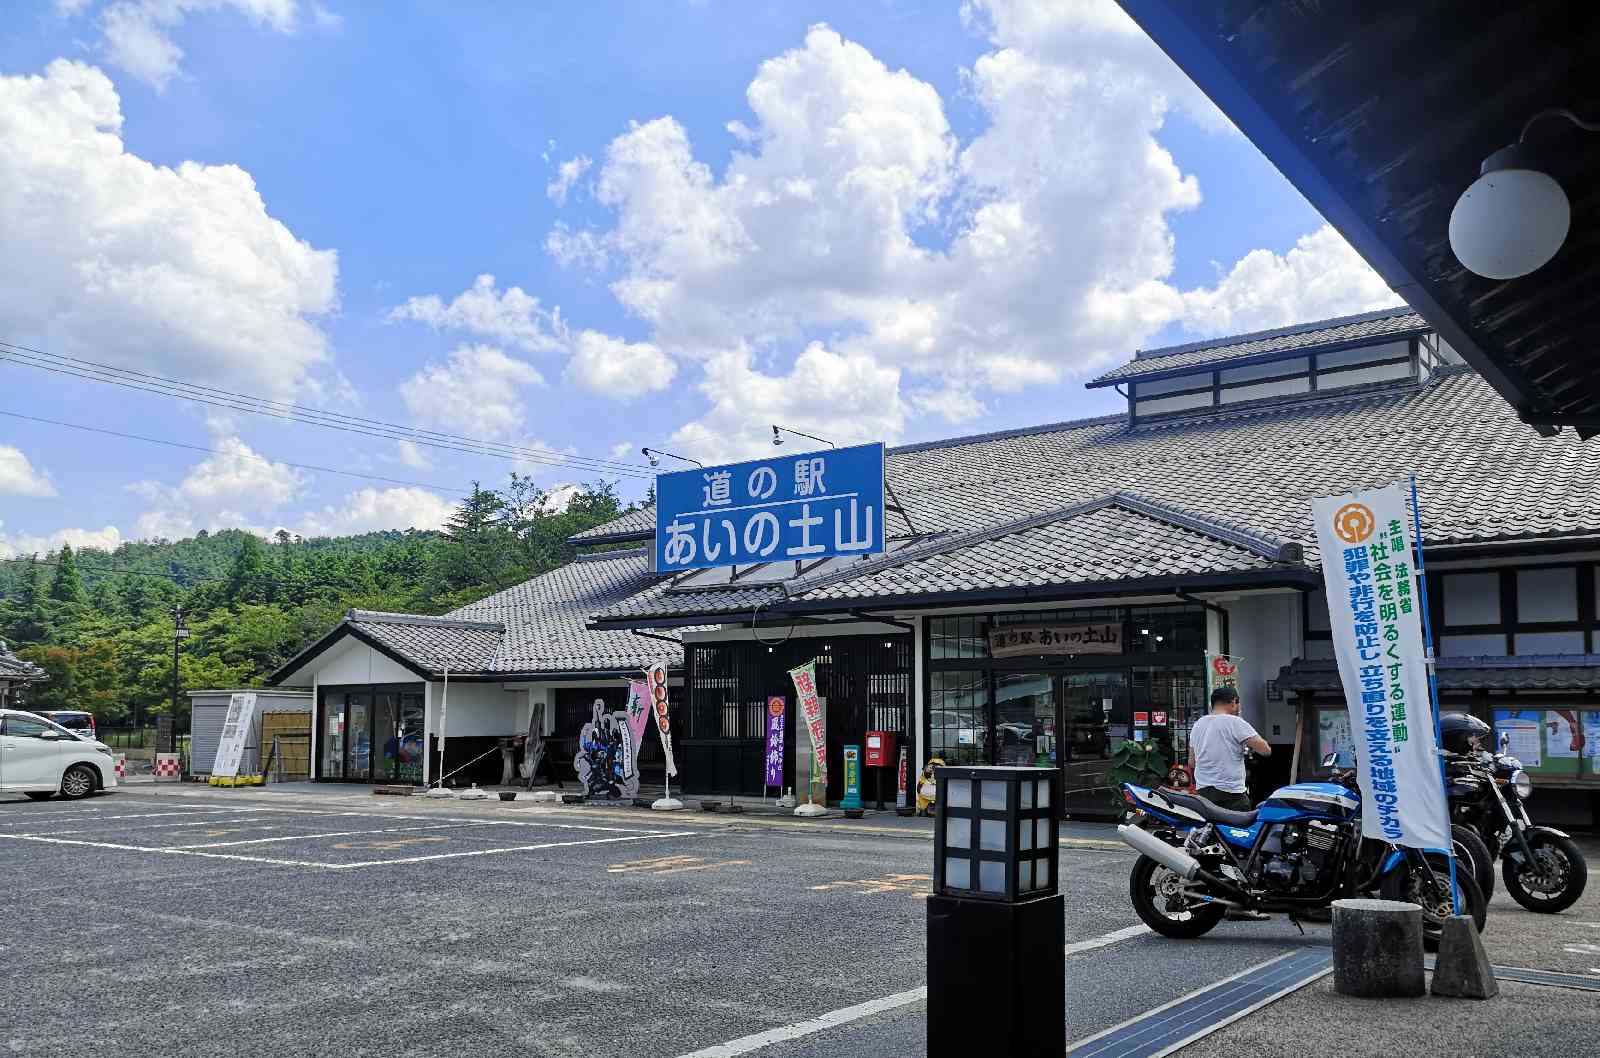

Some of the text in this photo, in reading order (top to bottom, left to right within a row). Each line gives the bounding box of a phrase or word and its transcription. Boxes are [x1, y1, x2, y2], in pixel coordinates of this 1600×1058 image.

[702, 457, 826, 507] 道の駅
[664, 499, 873, 565] あいの土山
[1395, 562, 1412, 614] 法務省
[1039, 625, 1118, 646] あいの土山
